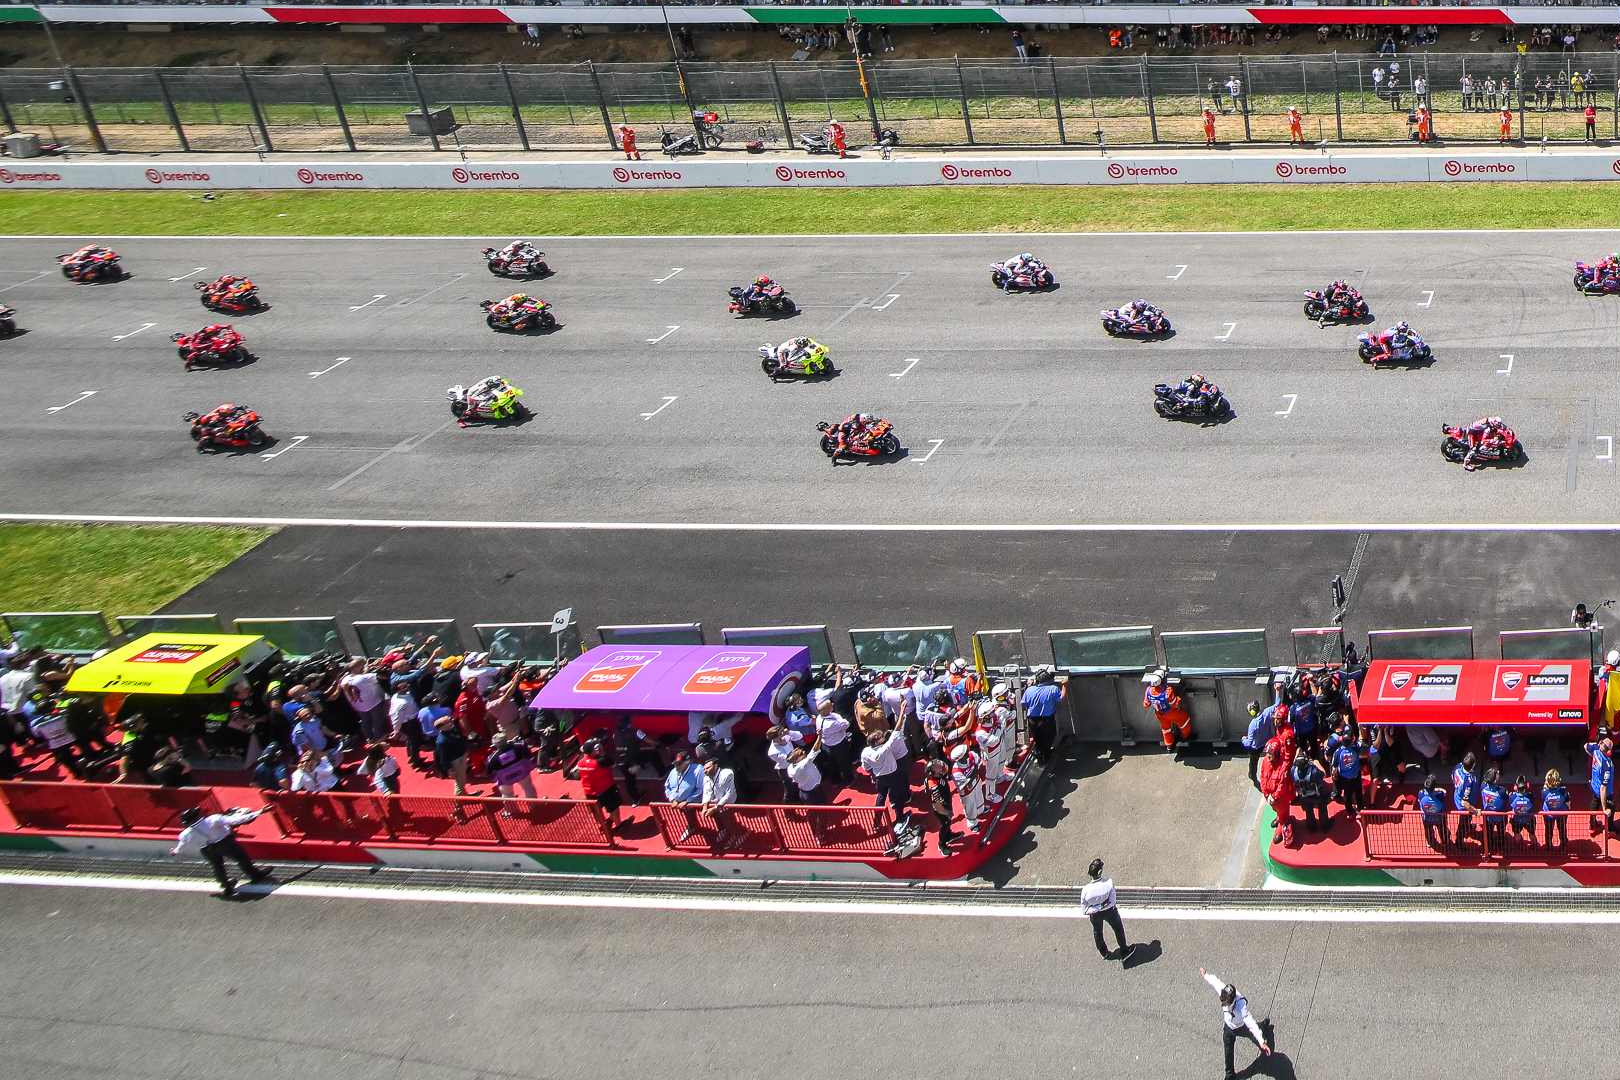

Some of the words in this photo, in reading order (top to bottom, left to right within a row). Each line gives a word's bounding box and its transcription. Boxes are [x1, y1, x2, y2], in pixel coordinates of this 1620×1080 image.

[793, 169, 844, 180] brembo
[960, 167, 1011, 178] brembo
[1126, 166, 1179, 177] brembo
[1295, 165, 1345, 176] brembo
[1463, 164, 1514, 175] brembo
[15, 171, 61, 181] brembo
[163, 171, 210, 181] brembo
[314, 171, 364, 181] brembo
[469, 171, 520, 181] brembo
[631, 170, 682, 180] brembo
[1418, 675, 1454, 685] Lenovo
[1529, 675, 1566, 685] Lenovo
[1546, 711, 1553, 719] by
[1559, 710, 1582, 718] Lenovo
